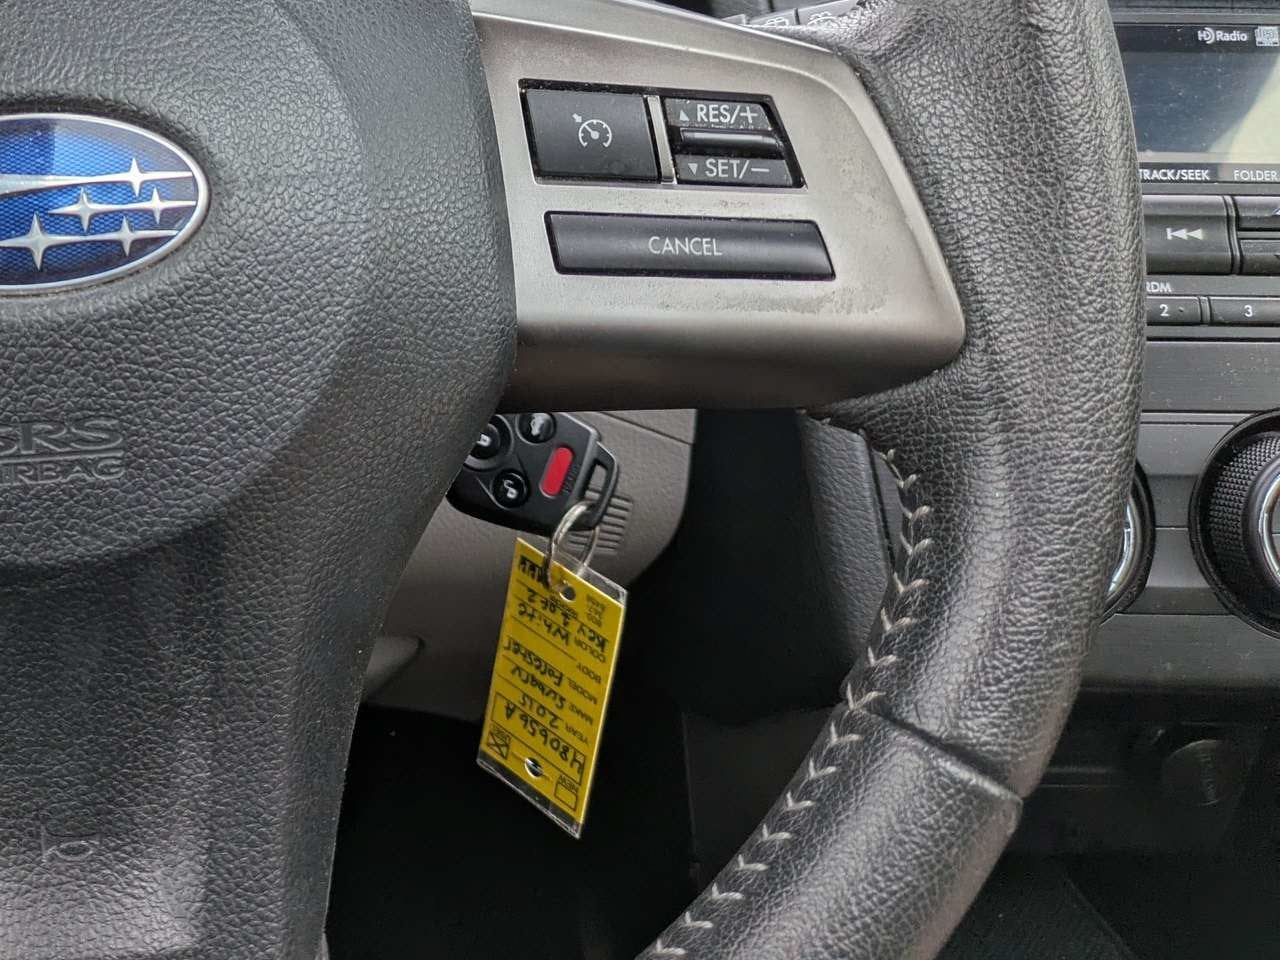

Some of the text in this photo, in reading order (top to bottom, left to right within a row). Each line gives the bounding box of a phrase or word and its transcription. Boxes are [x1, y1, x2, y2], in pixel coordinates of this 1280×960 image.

[1216, 30, 1248, 41] Radio
[1138, 168, 1211, 181] TRACK/SEEK
[648, 236, 724, 257] CANCEL
[1159, 303, 1170, 317] 2
[1243, 304, 1254, 318] 3
